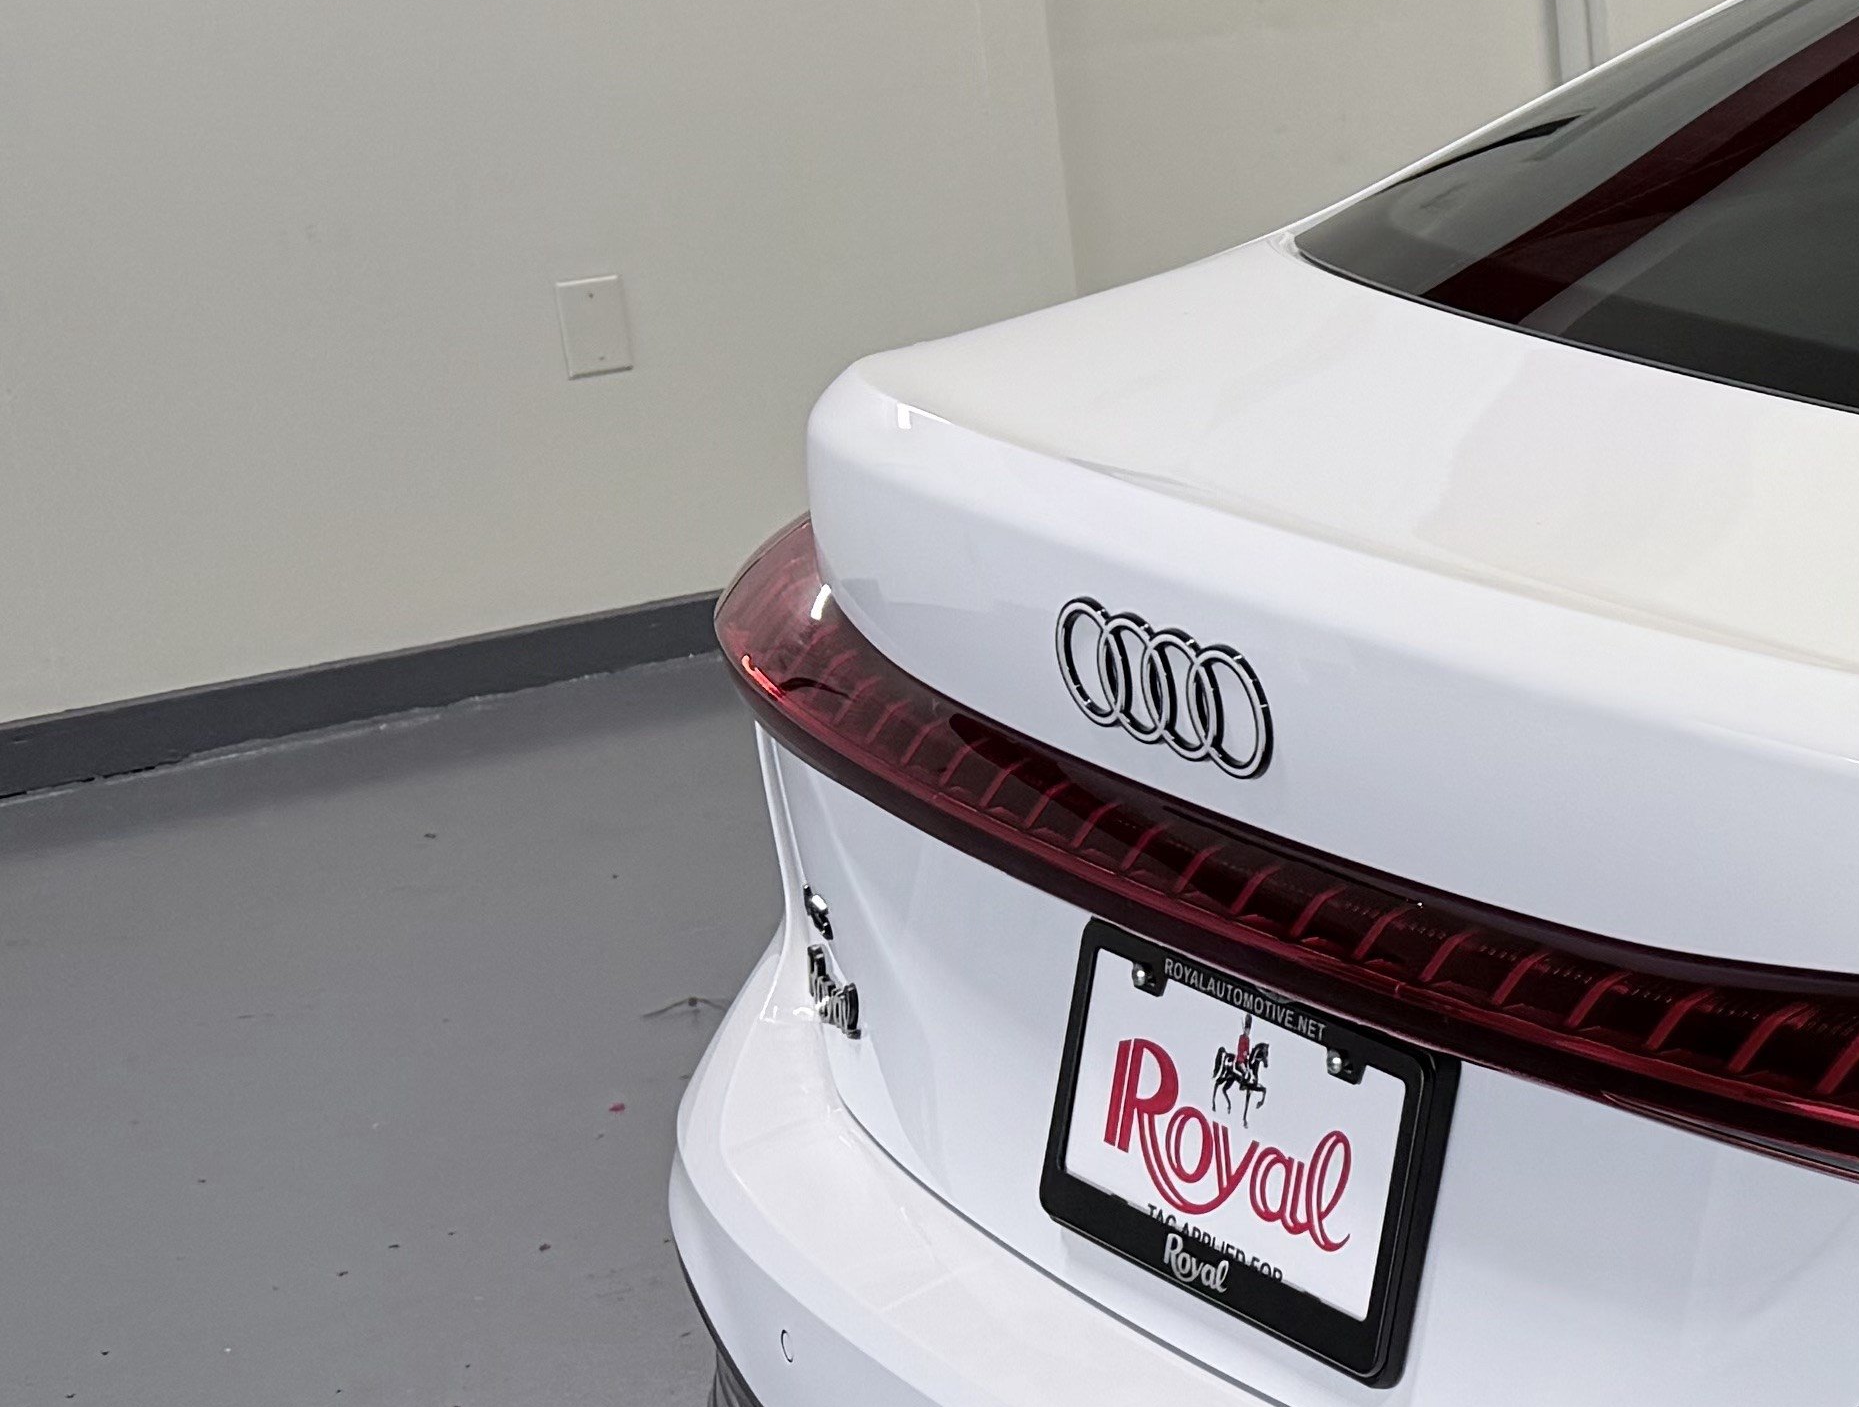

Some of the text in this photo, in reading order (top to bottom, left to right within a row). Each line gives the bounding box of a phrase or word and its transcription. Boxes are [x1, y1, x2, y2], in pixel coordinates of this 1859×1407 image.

[1164, 957, 1328, 1041] ROYALAUTOMOTIVE.NET
[1103, 1037, 1351, 1252] Royal
[1163, 1233, 1229, 1293] Royal
